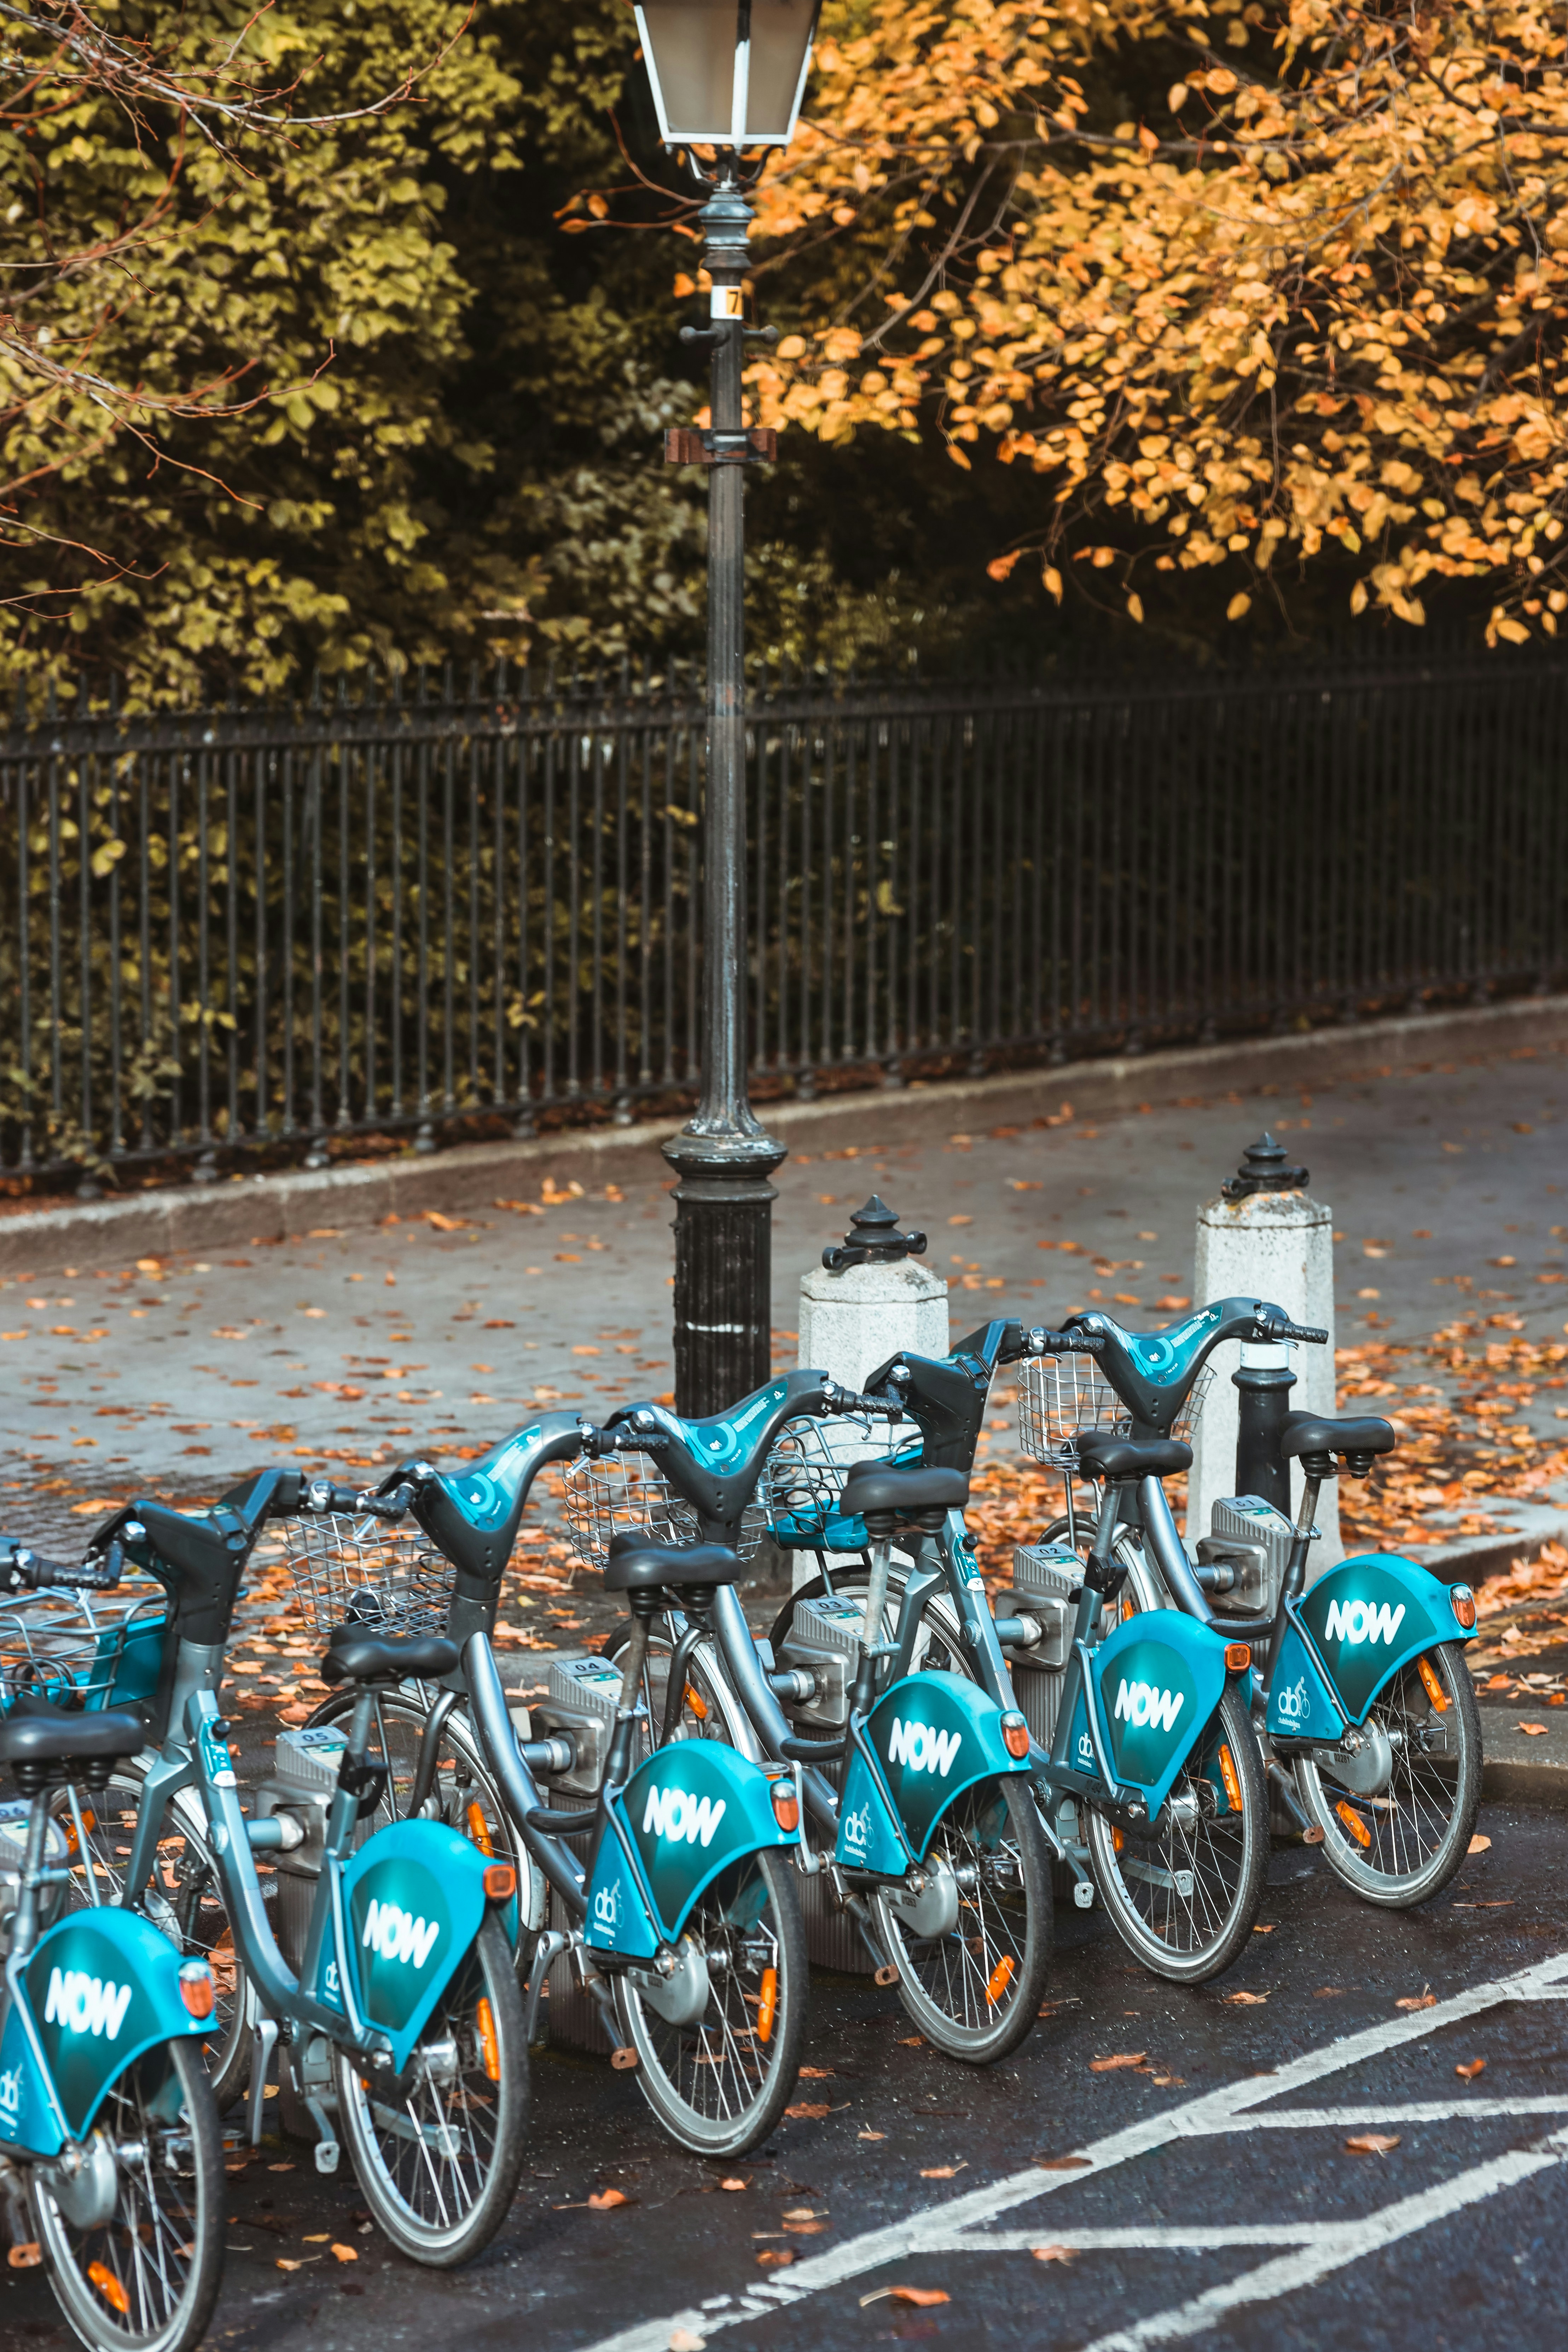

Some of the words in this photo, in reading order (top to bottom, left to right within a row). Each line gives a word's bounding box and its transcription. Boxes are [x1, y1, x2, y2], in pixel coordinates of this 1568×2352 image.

[728, 291, 738, 313] 7
[819, 1601, 842, 1609] 03
[1325, 1600, 1405, 1645] NOW
[575, 1663, 599, 1671] 04
[1115, 1679, 1184, 1732] NOW
[302, 1732, 328, 1742] 05
[889, 1718, 961, 1777] NOW
[1334, 1753, 1350, 1764] 02281
[643, 1785, 726, 1847] NOW
[363, 1900, 439, 1968] NOW
[46, 1968, 131, 2039] NOW
